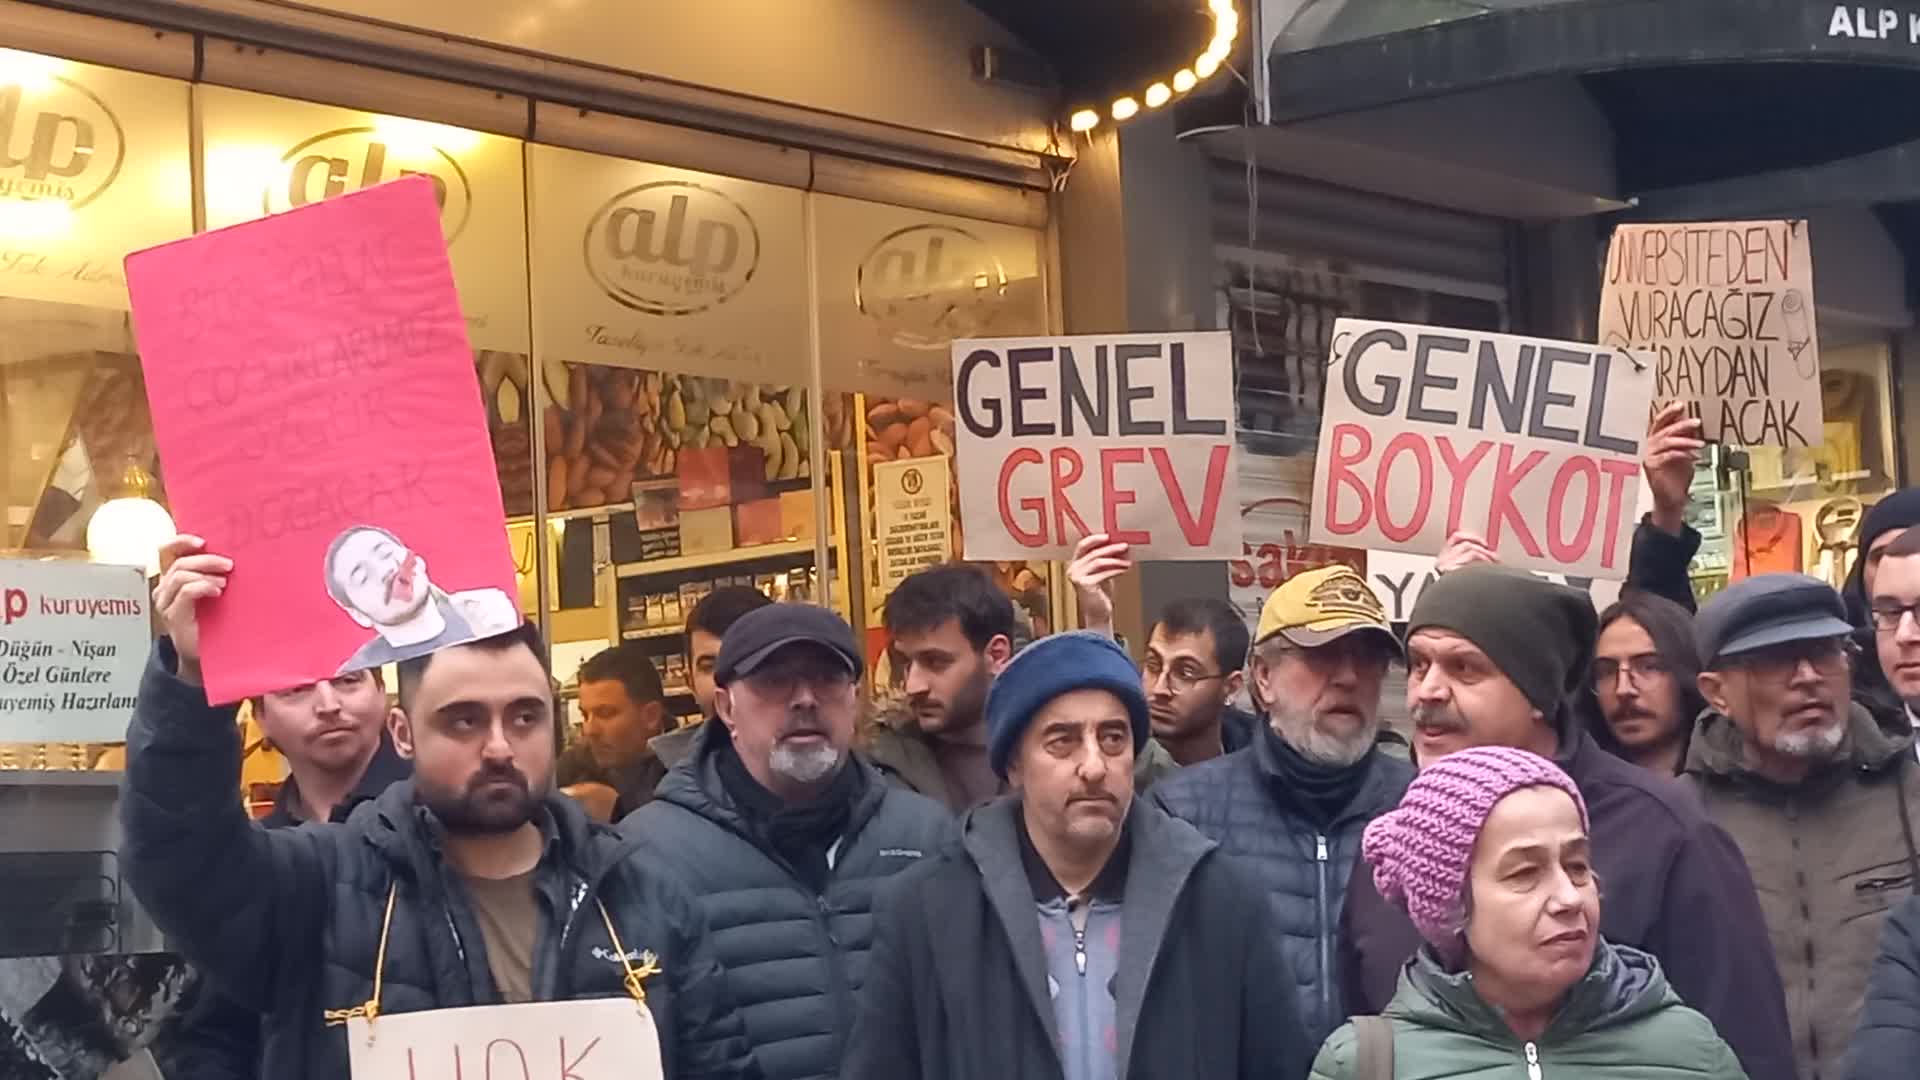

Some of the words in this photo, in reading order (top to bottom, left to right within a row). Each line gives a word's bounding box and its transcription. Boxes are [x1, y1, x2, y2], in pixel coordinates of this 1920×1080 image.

[1828, 5, 1898, 39] ALP
[606, 194, 739, 275] alp
[956, 342, 1227, 439] GENEL
[1342, 327, 1640, 456] GENEL
[997, 444, 1231, 548] GREV
[1324, 422, 1642, 569] BOYKOT
[3, 661, 40, 685] Özel
[46, 665, 111, 684] Günlere
[72, 639, 117, 661] Nişan
